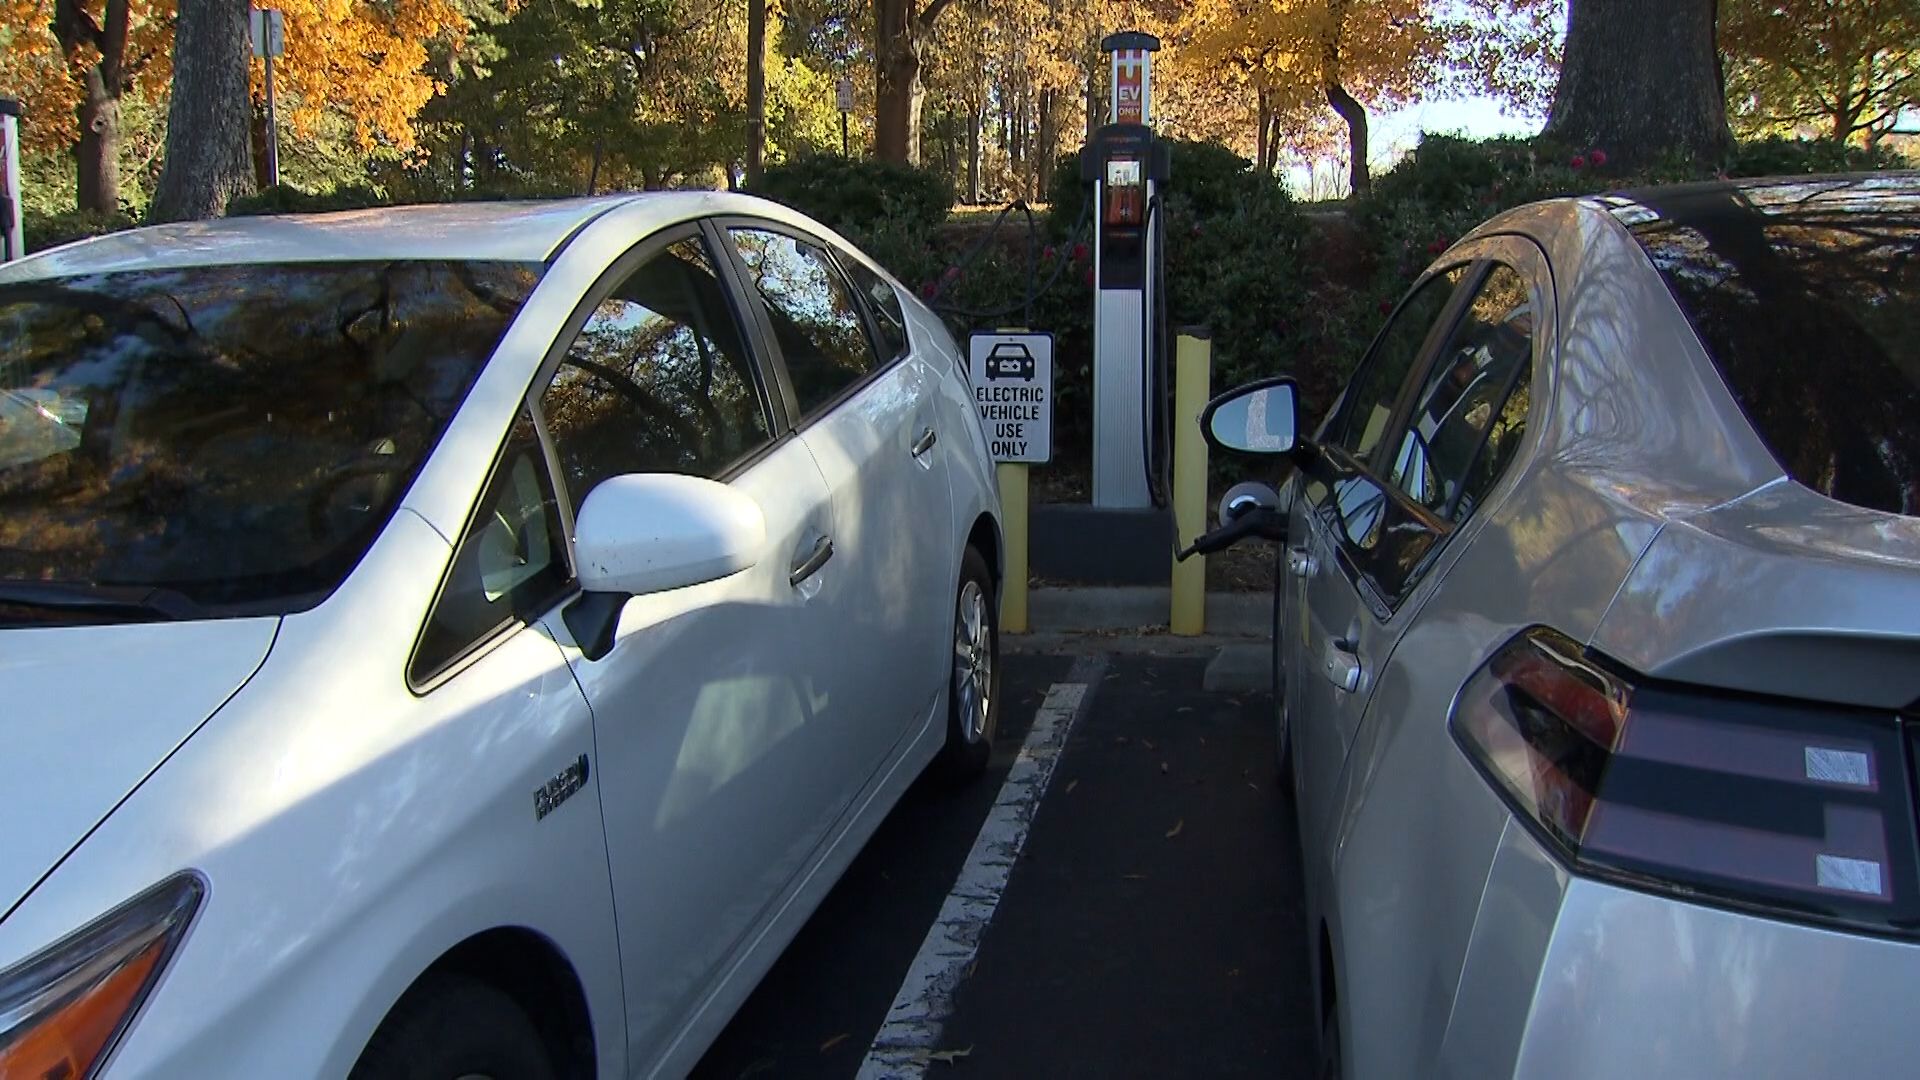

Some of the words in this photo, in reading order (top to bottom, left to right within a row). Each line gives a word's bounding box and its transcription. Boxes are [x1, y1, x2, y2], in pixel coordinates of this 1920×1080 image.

[1119, 87, 1140, 100] EV
[1118, 107, 1141, 116] ONLY
[976, 387, 1044, 402] ELECTRIC
[980, 405, 1039, 420] VEHICLE
[996, 423, 1023, 438] USE
[991, 441, 1028, 456] ONLY
